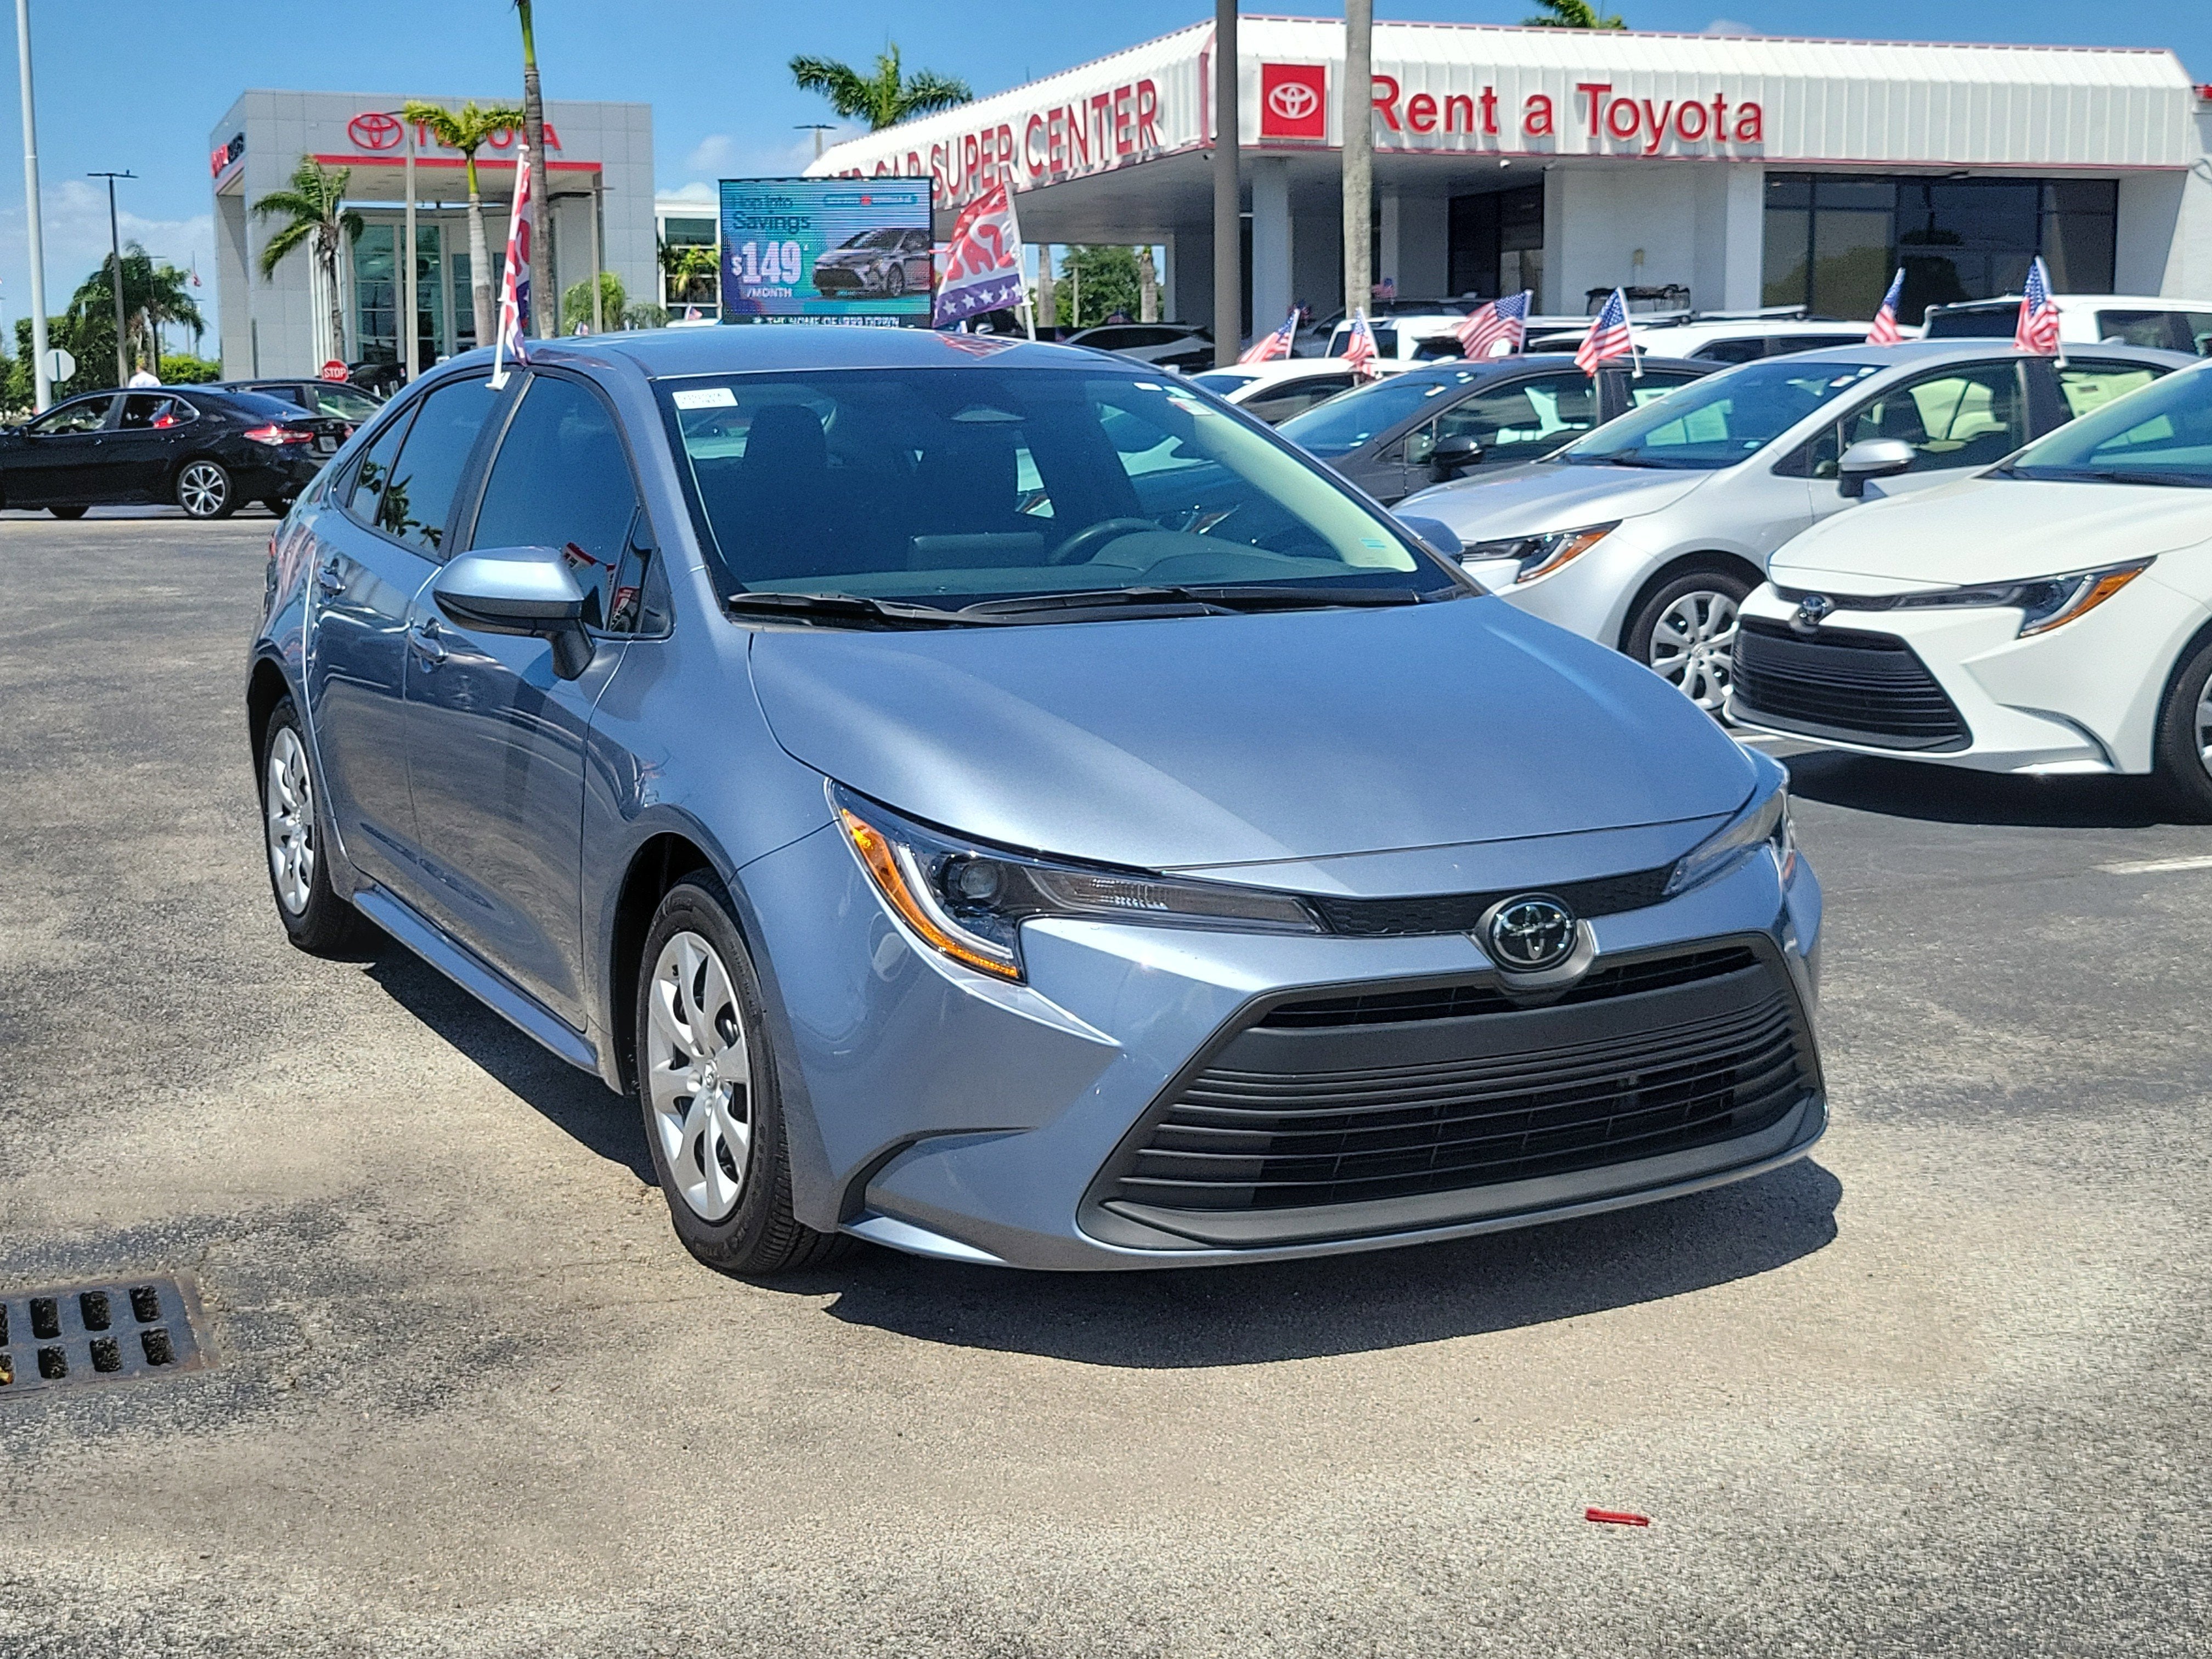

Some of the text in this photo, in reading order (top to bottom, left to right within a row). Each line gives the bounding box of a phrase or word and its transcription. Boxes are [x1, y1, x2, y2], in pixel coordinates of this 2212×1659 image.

[1371, 75, 1763, 154] Rent a Toyota
[415, 117, 562, 150] TOA
[931, 123, 1014, 201] SUPER
[1025, 78, 1158, 178] CENTER
[733, 211, 811, 234] Savings
[747, 287, 793, 297] /MONTH
[324, 367, 346, 378] STOP
